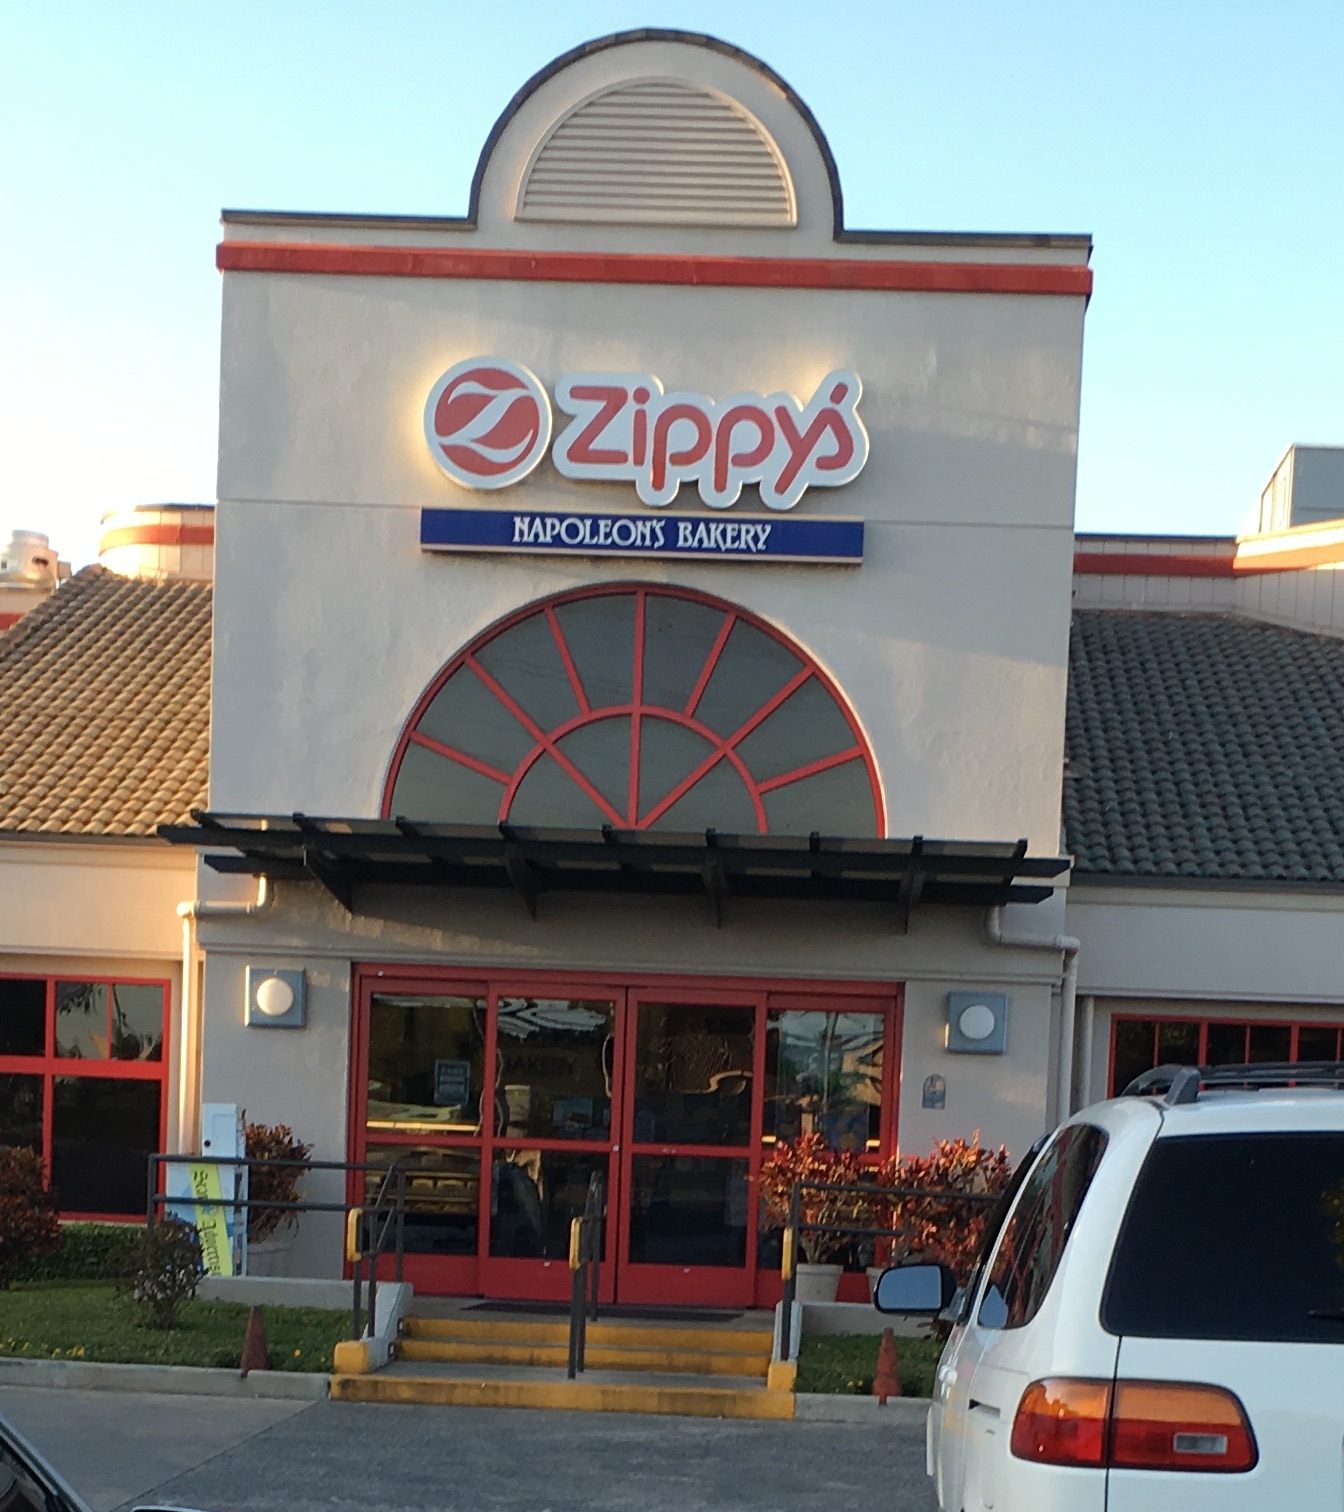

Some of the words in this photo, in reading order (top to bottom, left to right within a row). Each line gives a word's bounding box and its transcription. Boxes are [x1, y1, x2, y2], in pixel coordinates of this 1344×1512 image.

[567, 381, 855, 496] Zippy's
[513, 516, 666, 549] NAPOLEON'S
[677, 520, 772, 553] BAKERY
